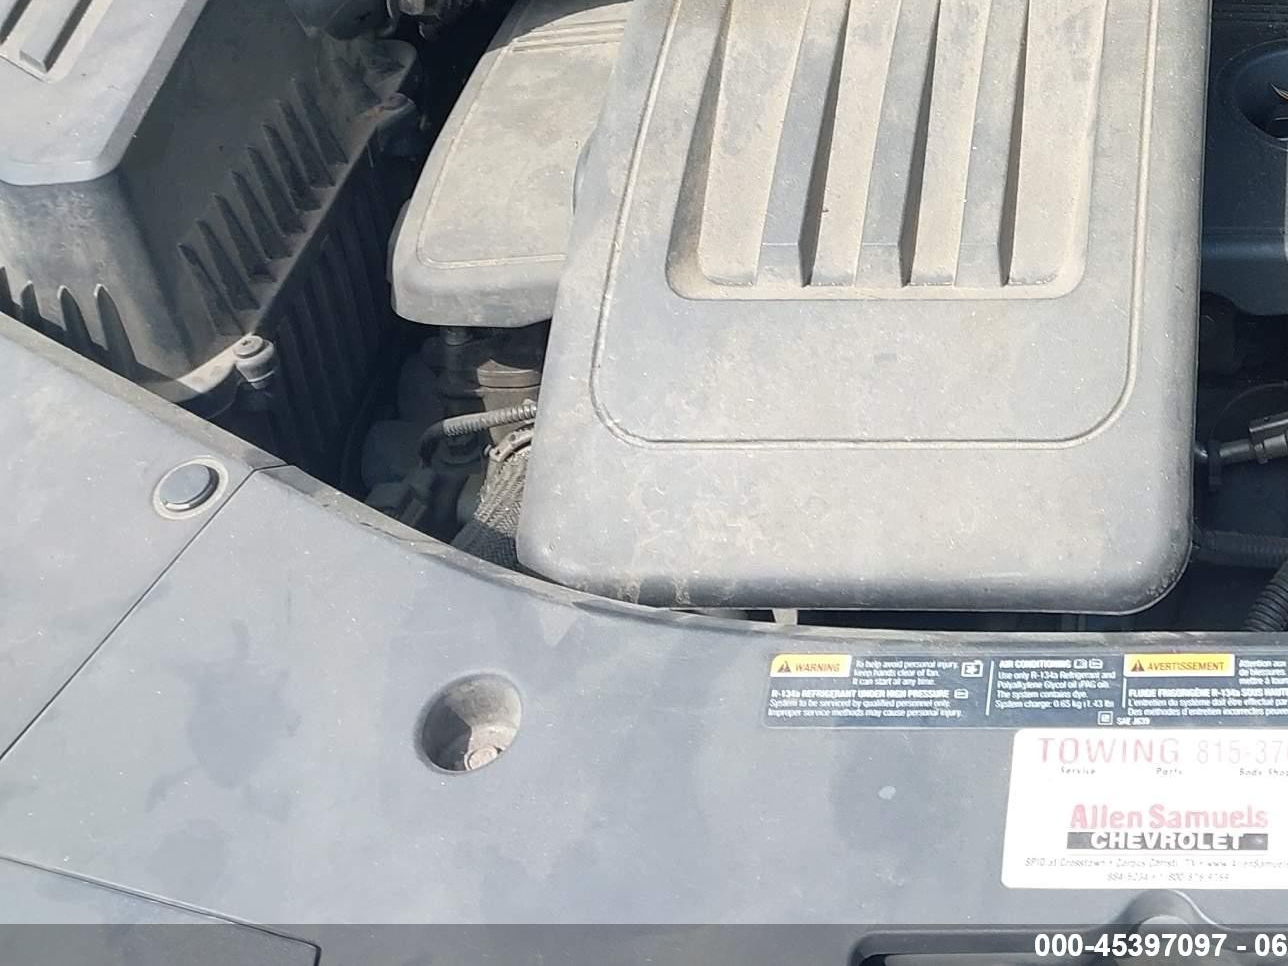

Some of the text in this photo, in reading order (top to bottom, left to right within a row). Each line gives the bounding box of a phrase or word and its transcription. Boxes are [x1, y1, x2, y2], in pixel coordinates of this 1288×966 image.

[796, 663, 840, 672] WARNING
[1147, 662, 1224, 670] AVERTISSEMENT
[1038, 737, 1180, 764] TOWING
[1060, 766, 1096, 775] Service
[1070, 803, 1269, 830] Allen Samuels
[1090, 831, 1244, 850] CHEVROLET
